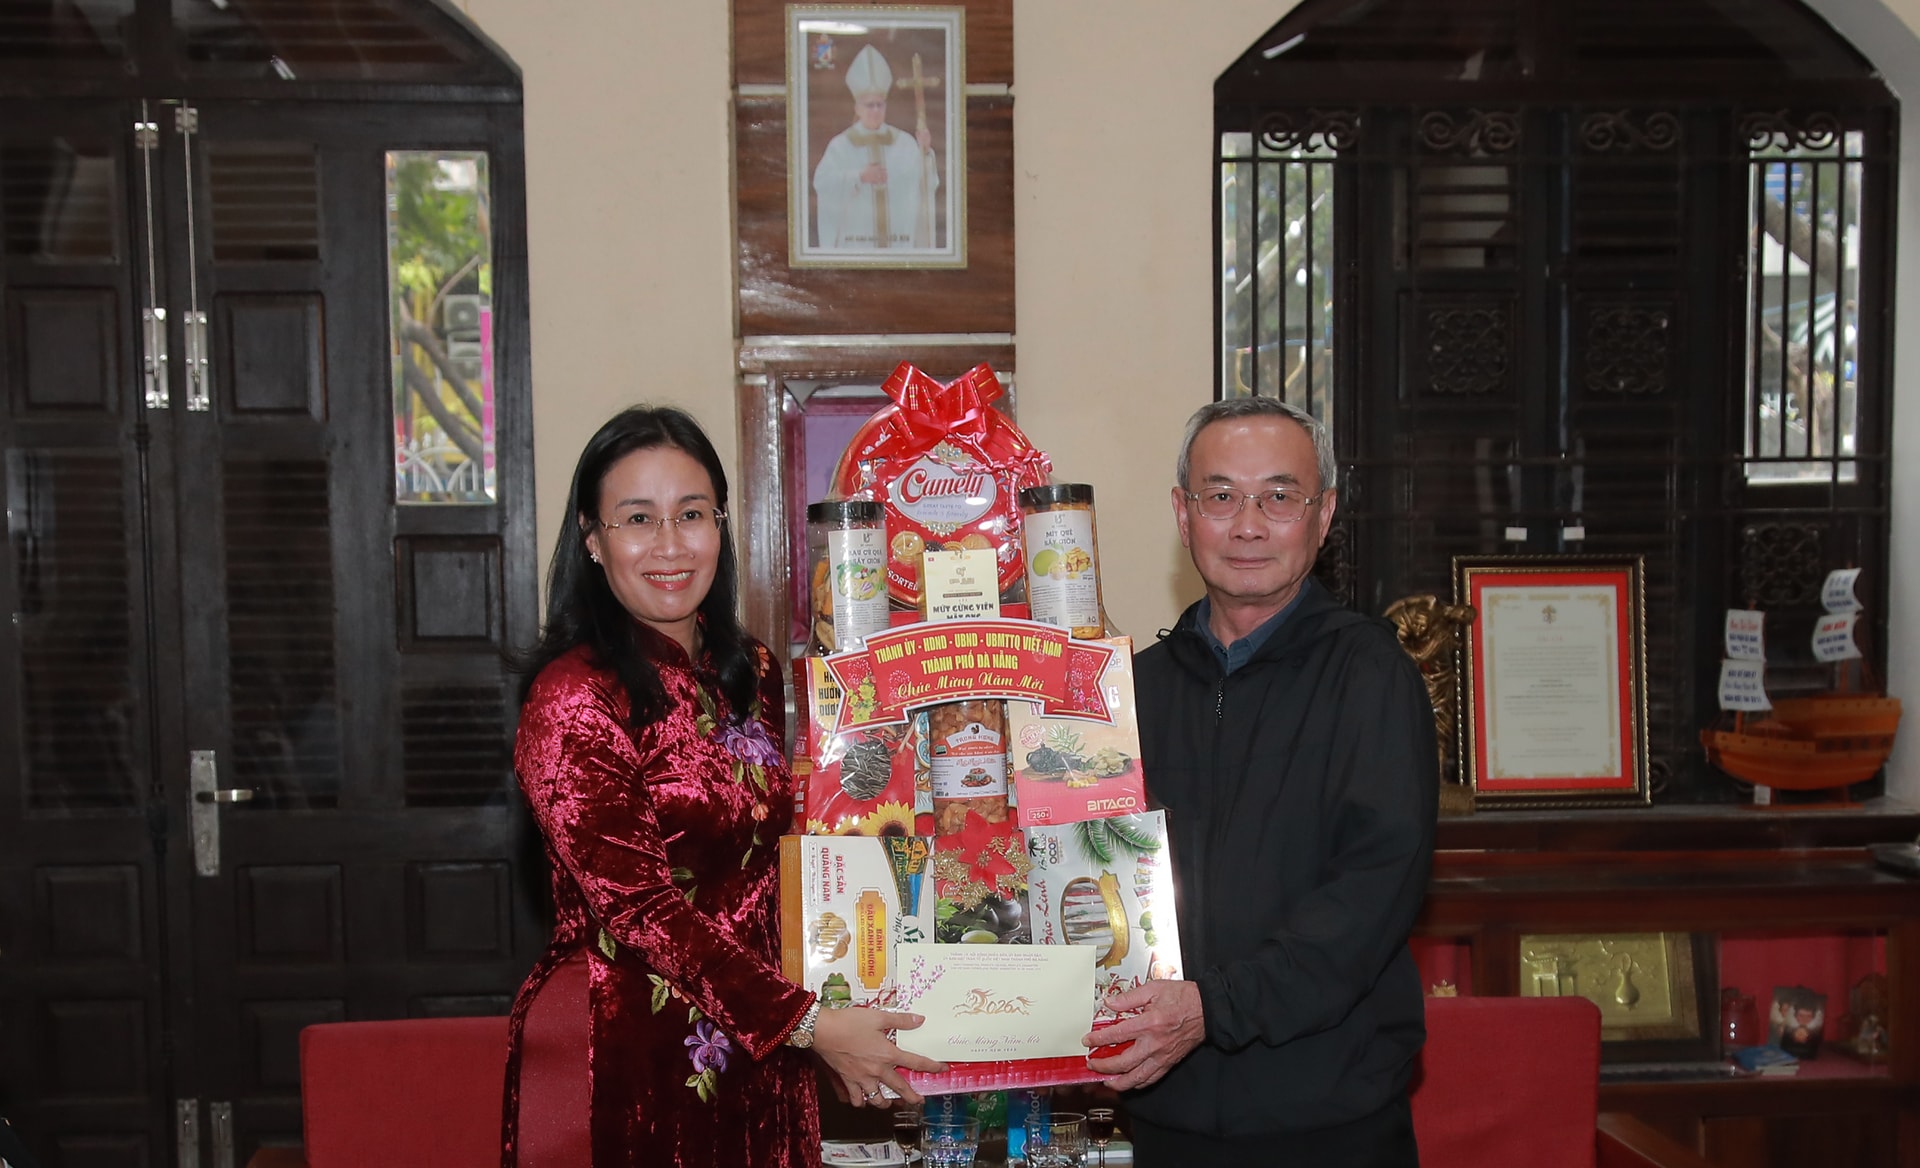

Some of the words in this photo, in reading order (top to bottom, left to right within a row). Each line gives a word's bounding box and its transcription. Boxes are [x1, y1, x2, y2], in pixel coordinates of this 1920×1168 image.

[899, 467, 985, 504] Camely
[874, 644, 904, 664] THÀNH
[954, 633, 978, 648] UBND
[985, 632, 1021, 651] UBMTTQ
[1042, 640, 1063, 658] NAM
[920, 655, 953, 675] THÀNH
[954, 649, 975, 670] PHỐ
[818, 684, 841, 700] HƯỚN
[897, 681, 931, 698] Chúc
[934, 675, 974, 689] Mừng
[978, 671, 1013, 686] Năm
[1016, 674, 1045, 691] Mới
[1087, 796, 1136, 812] BITACO
[820, 847, 831, 879] QUẢNG
[833, 855, 843, 873] ĐẶC
[1048, 836, 1057, 865] OCOP
[822, 880, 831, 902] NAM
[1034, 878, 1049, 918] Linh
